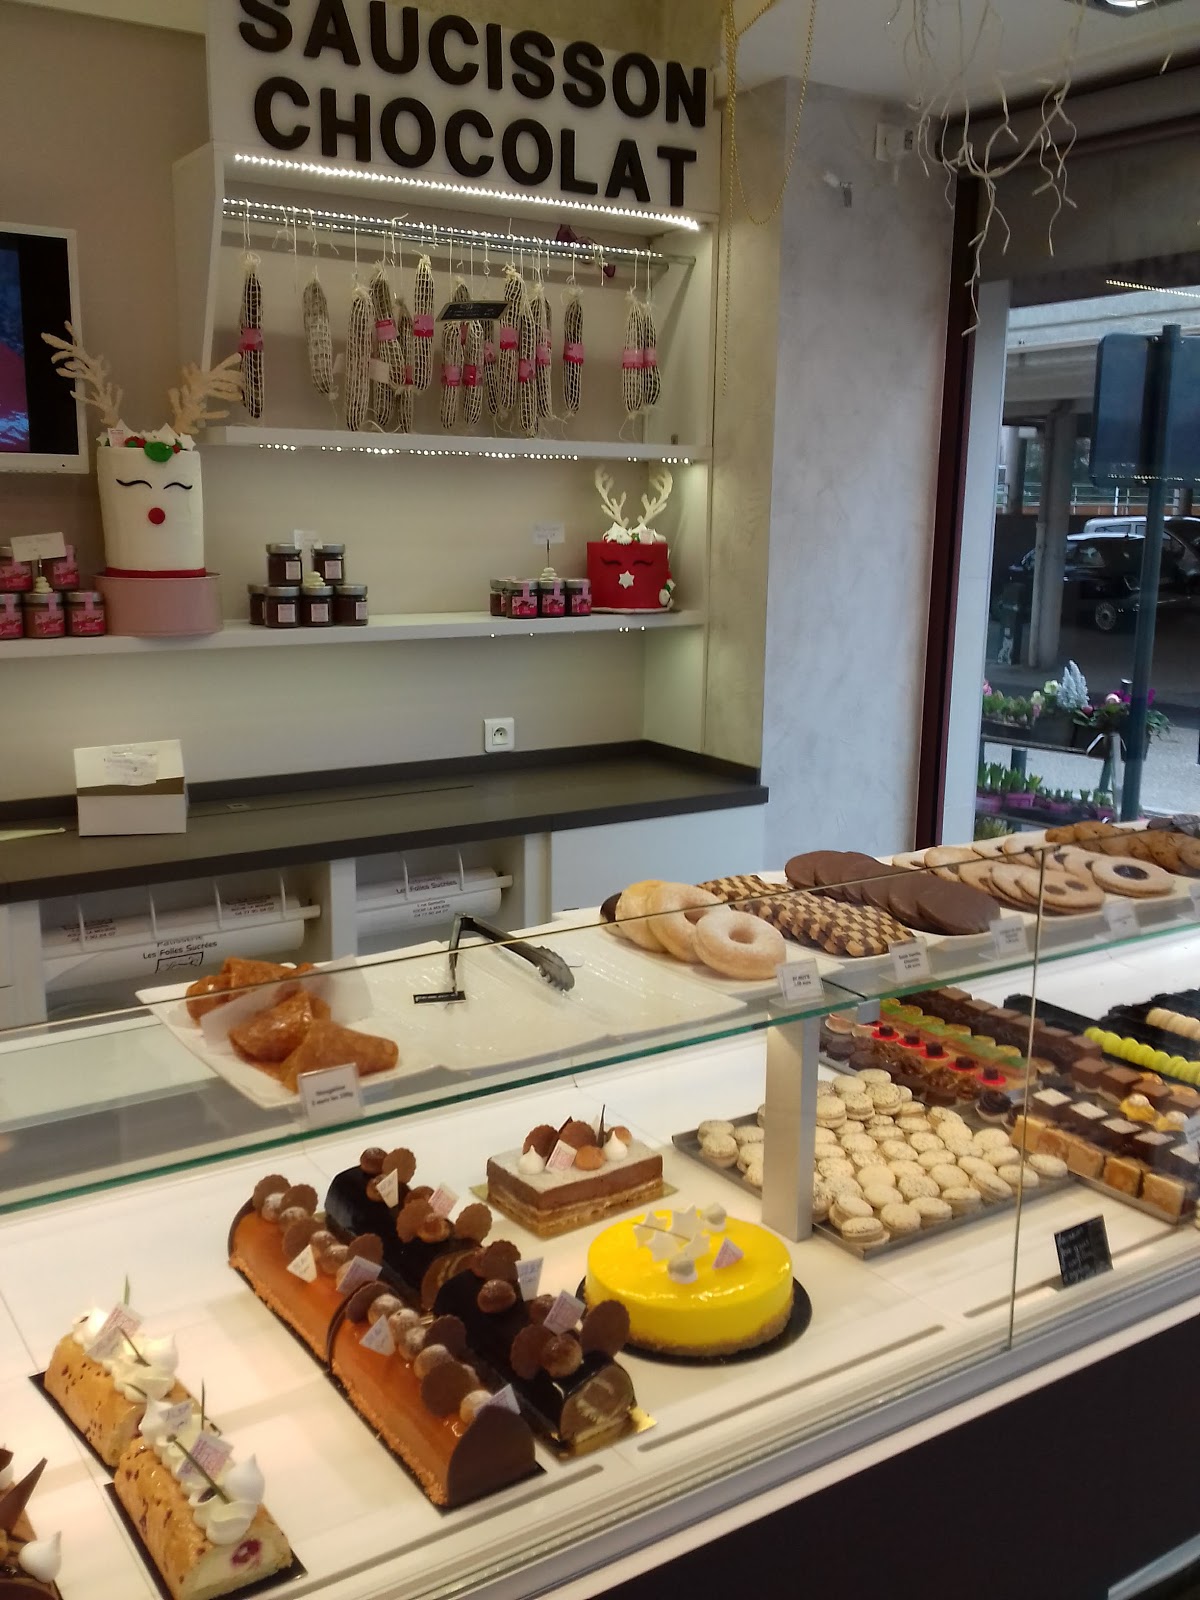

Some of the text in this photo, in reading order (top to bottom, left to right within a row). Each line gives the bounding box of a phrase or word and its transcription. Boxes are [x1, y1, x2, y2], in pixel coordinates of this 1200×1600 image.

[239, 0, 706, 127] SAUCISSON
[253, 76, 697, 207] CHOCOLAT
[143, 951, 156, 960] Les
